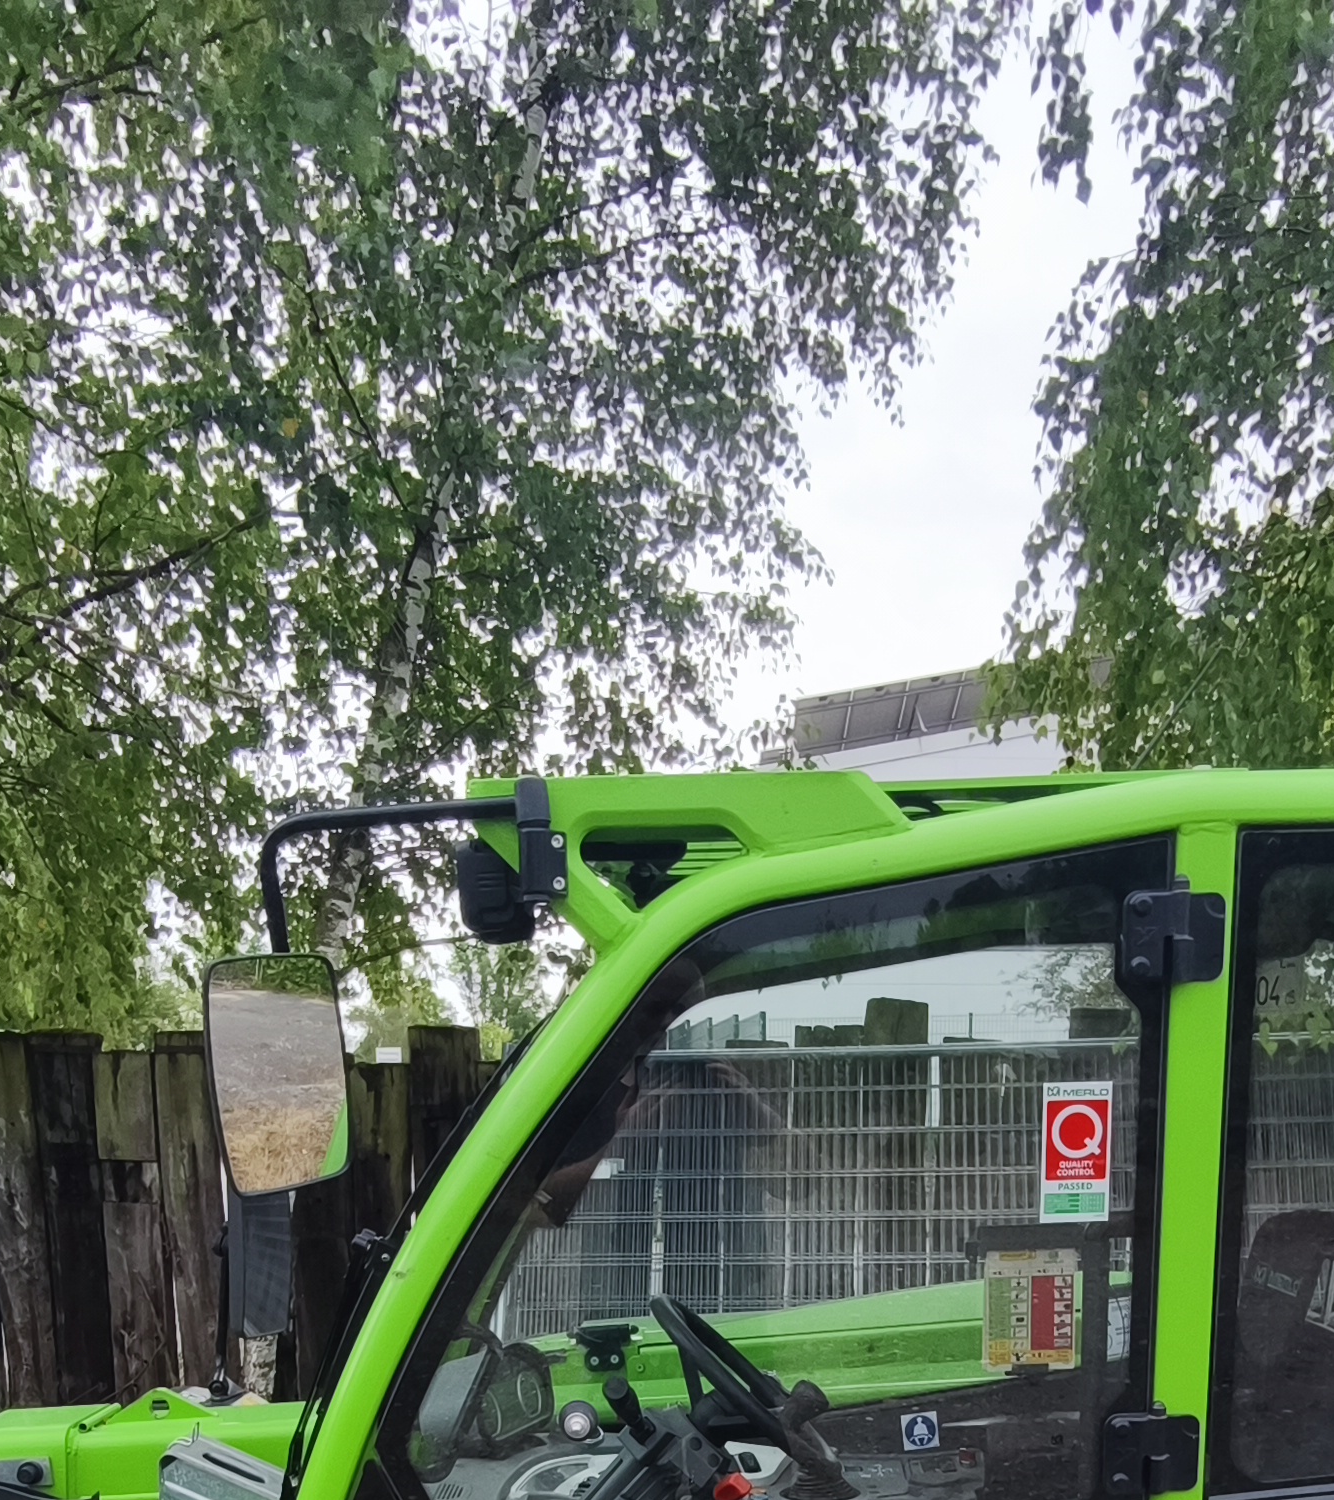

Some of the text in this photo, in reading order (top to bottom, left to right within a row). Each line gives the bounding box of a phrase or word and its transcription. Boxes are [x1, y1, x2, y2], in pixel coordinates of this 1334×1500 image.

[1062, 1088, 1109, 1097] MERLO
[1051, 1104, 1103, 1159] Q
[1058, 1160, 1094, 1169] QUALITY
[1056, 1168, 1095, 1177] CONTROL
[1058, 1182, 1093, 1190] PASSED
